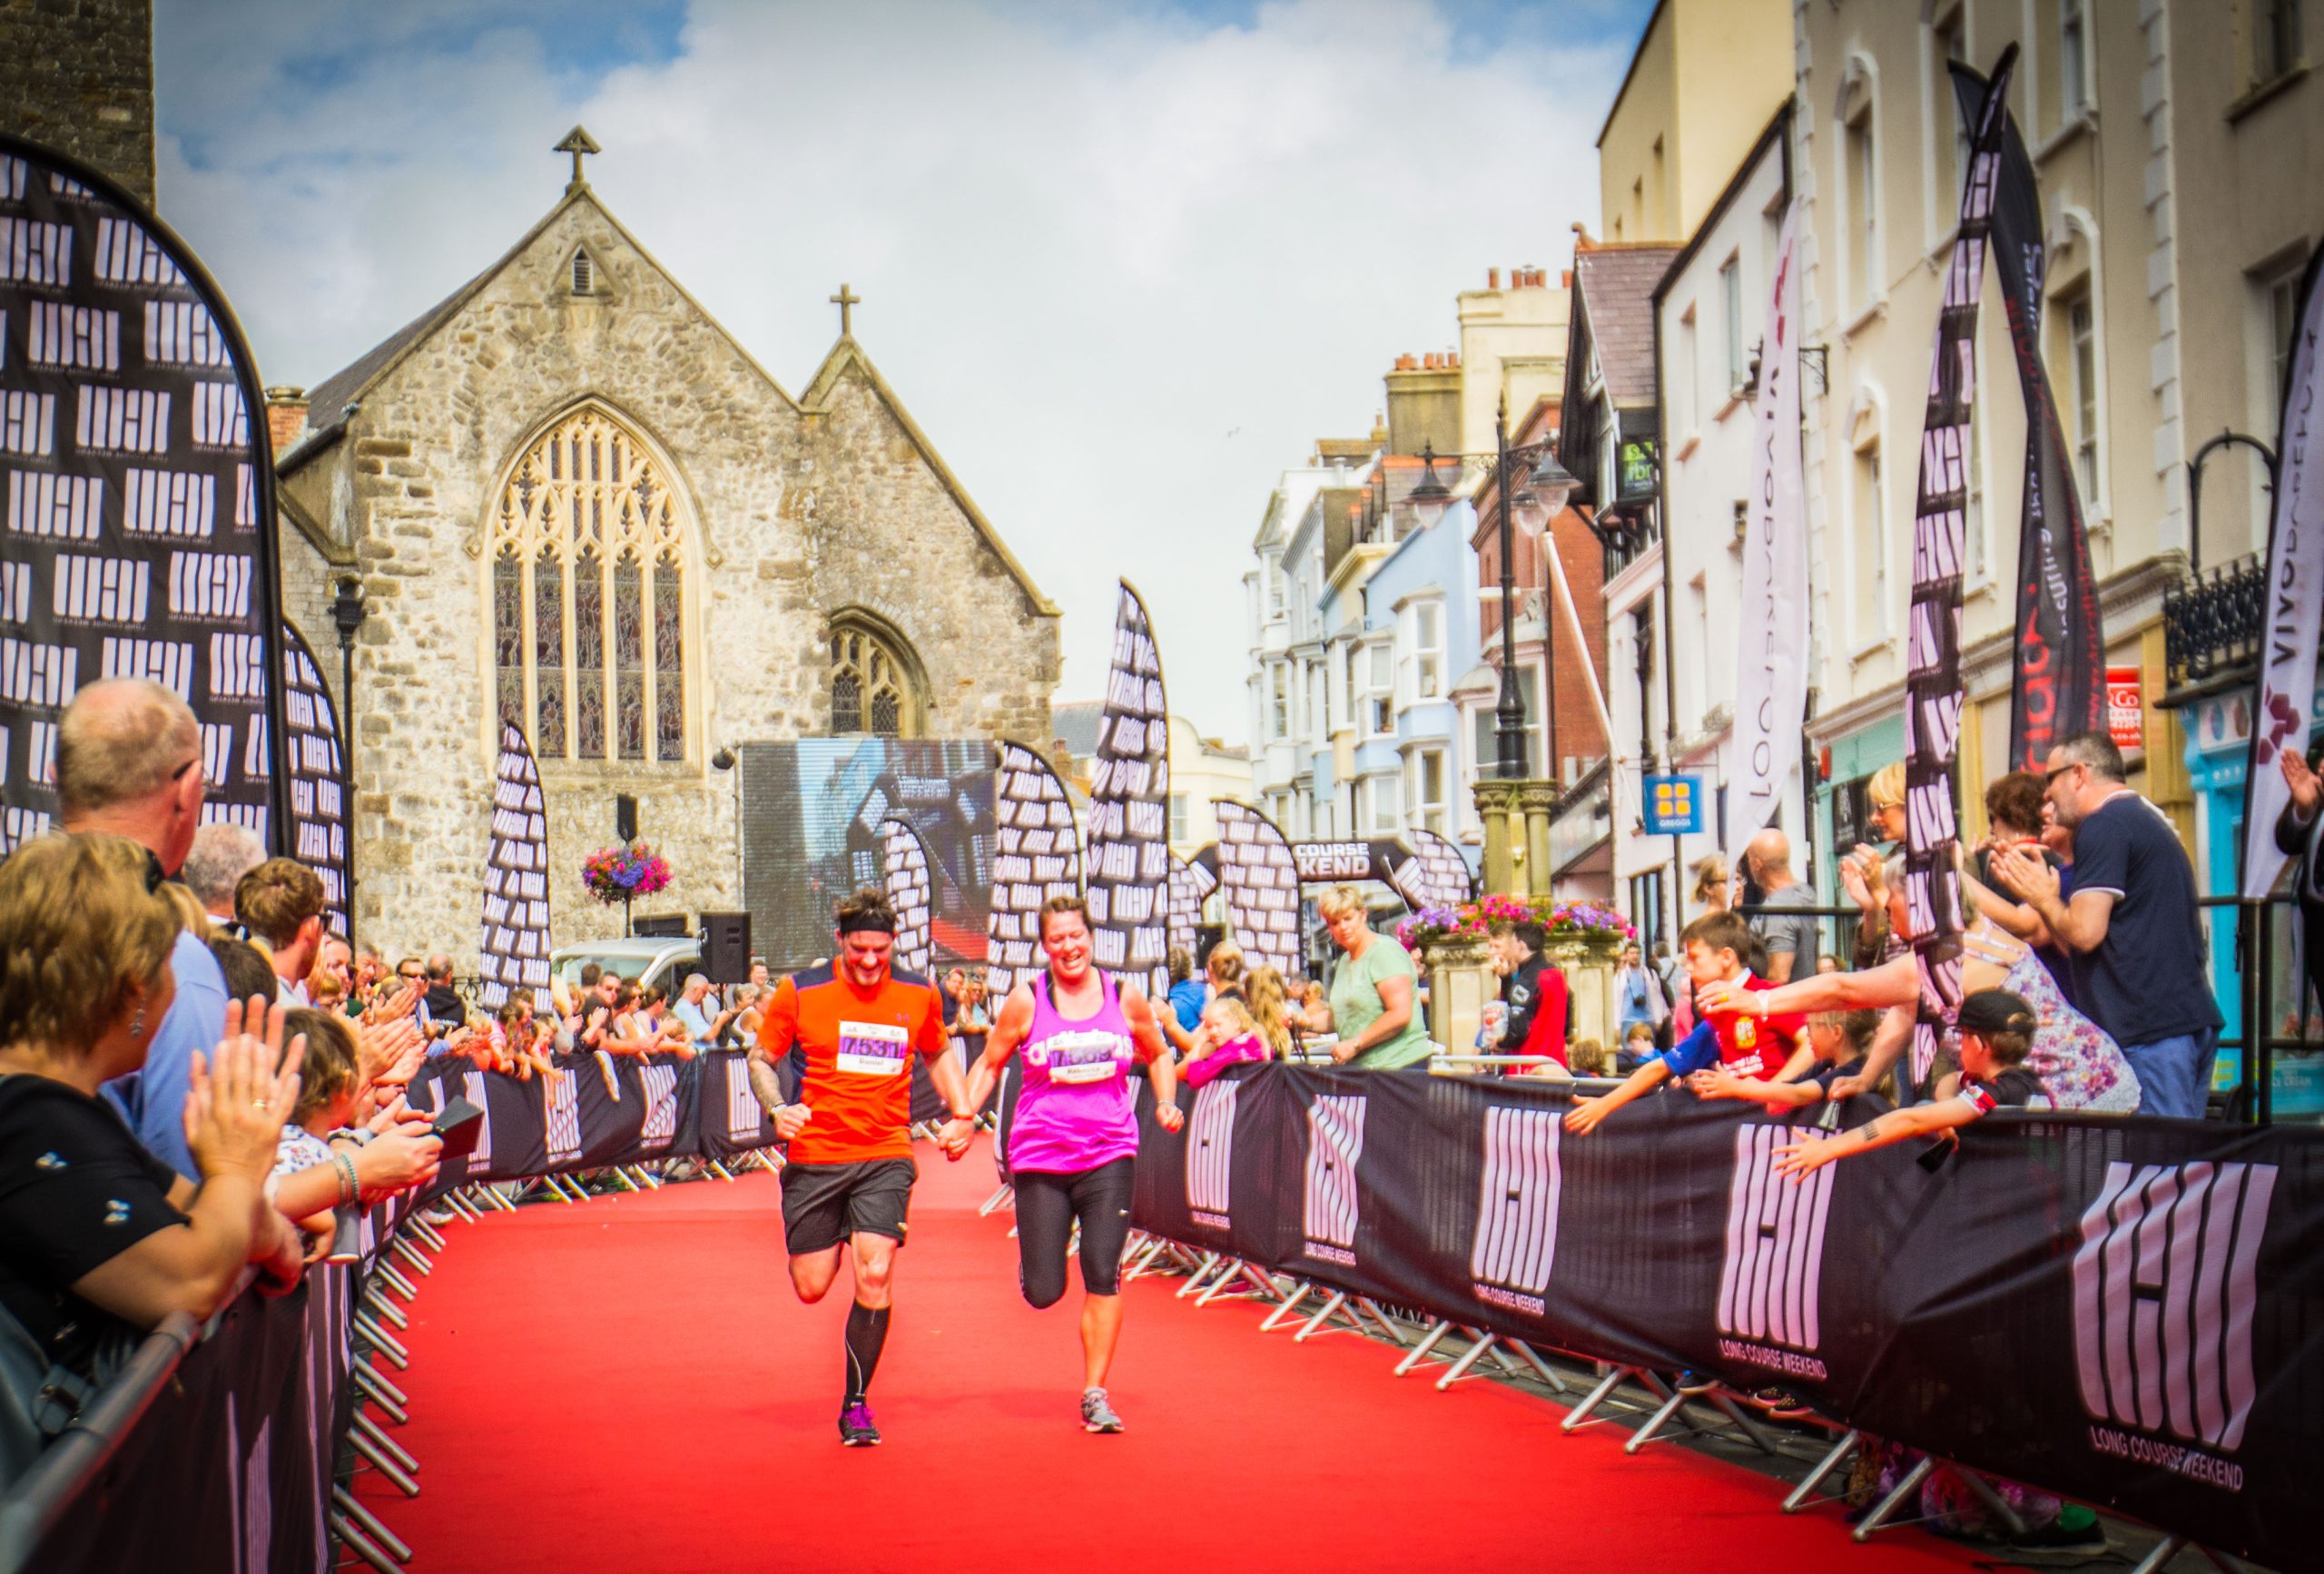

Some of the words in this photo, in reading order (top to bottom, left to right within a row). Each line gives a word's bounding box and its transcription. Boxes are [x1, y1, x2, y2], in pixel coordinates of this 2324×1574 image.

[1295, 842, 1370, 857] COURSE
[1299, 857, 1371, 877] KEND
[843, 1037, 900, 1059] 7531
[1473, 1282, 1492, 1301] LONG
[1491, 1287, 1516, 1308] COURSE
[1515, 1293, 1545, 1315] WEEKEND
[1719, 1338, 1747, 1360] LONG
[1747, 1343, 1782, 1369] COURSE
[1783, 1352, 1827, 1379] WEEKEND
[2091, 1425, 2128, 1456] LONG
[2131, 1435, 2186, 1471] COURSE
[2183, 1450, 2244, 1492] WEEKEND
